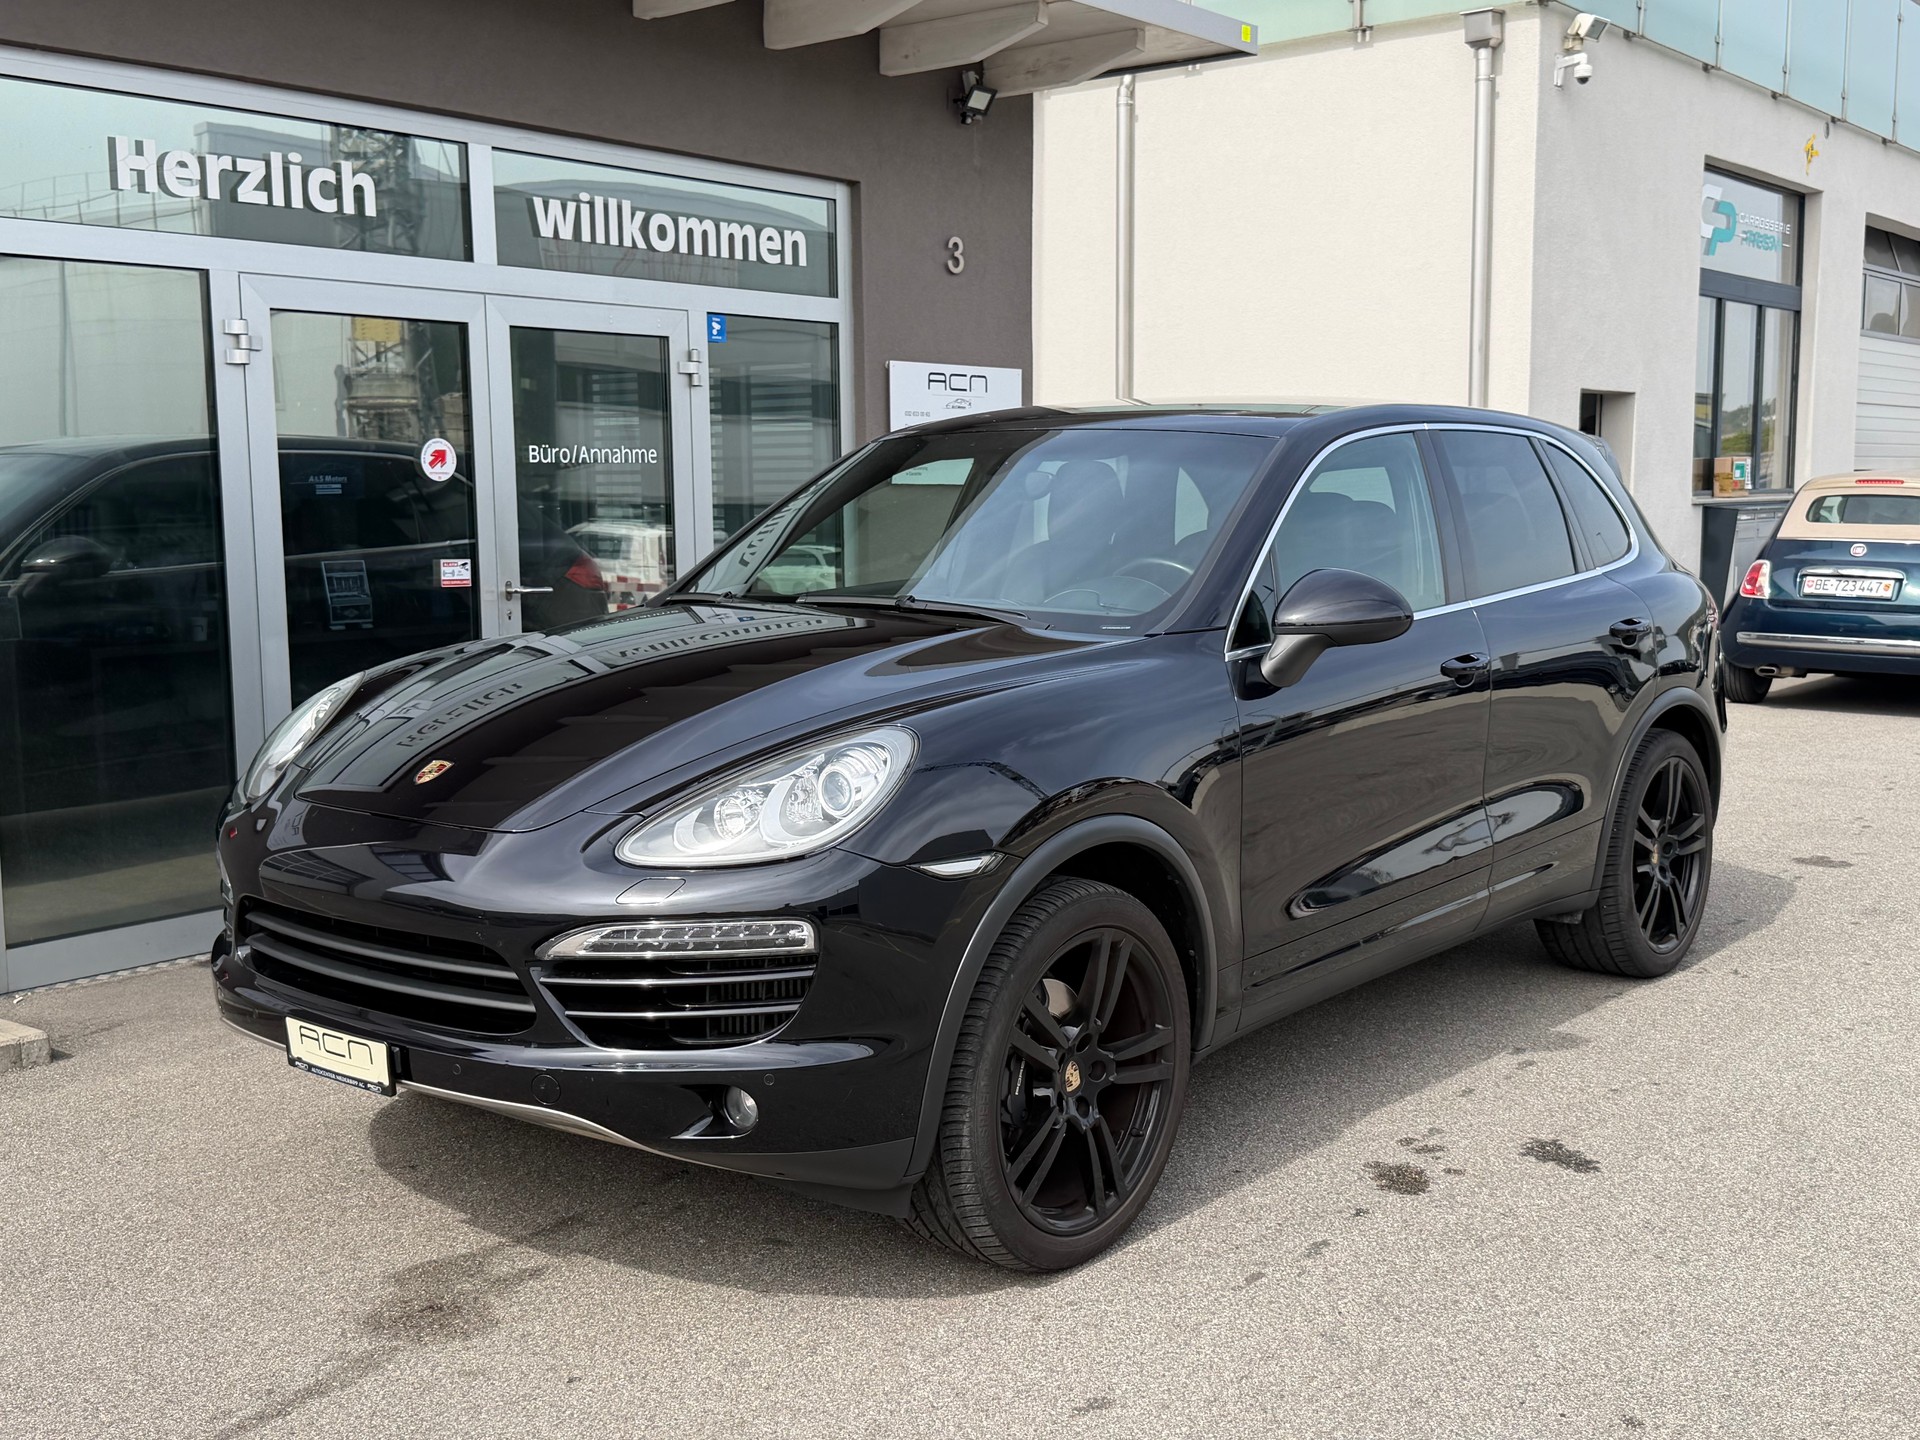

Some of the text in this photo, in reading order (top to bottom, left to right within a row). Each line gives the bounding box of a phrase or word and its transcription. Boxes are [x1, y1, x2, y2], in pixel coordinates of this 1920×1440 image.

[114, 135, 377, 217] Herzlich
[532, 191, 808, 267] willkommen
[1738, 212, 1791, 235] CARROSSERIE
[947, 236, 965, 274] 3
[528, 444, 658, 464] Büro/Annahme
